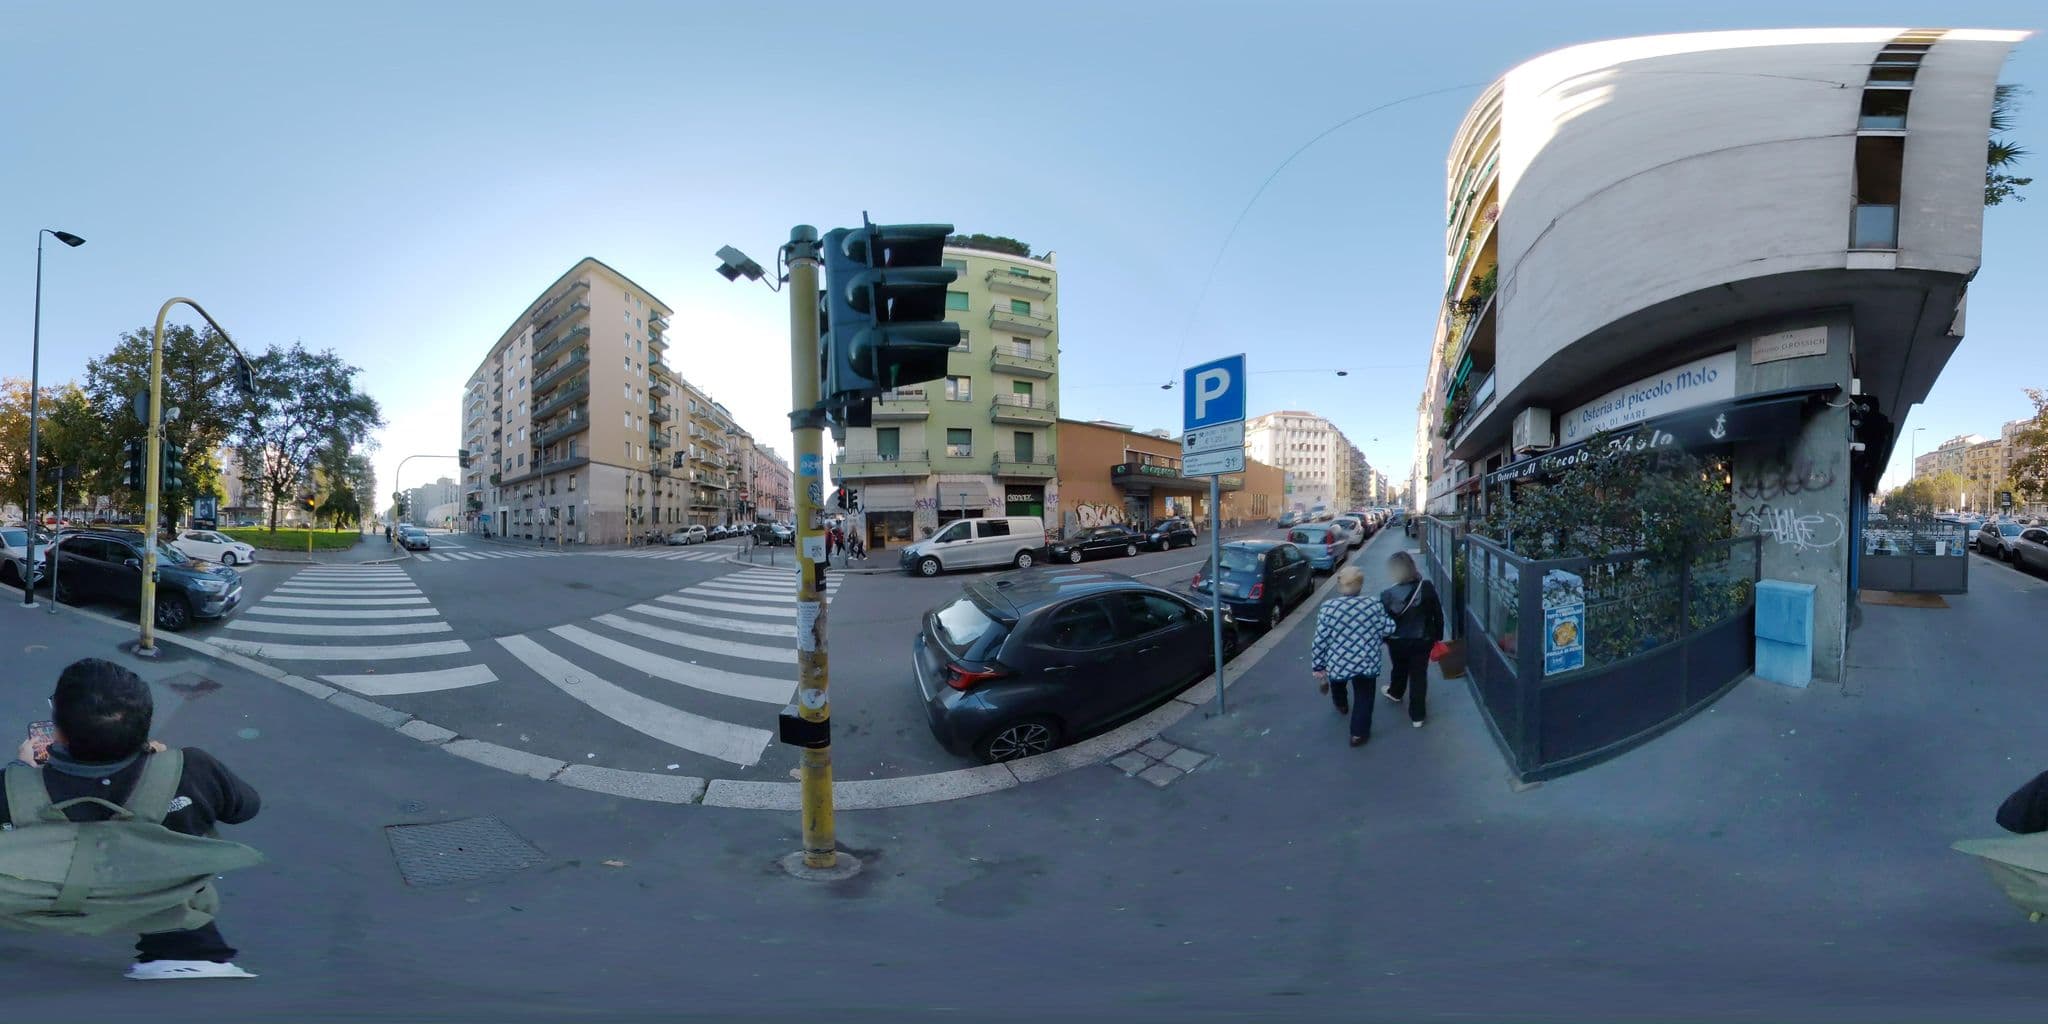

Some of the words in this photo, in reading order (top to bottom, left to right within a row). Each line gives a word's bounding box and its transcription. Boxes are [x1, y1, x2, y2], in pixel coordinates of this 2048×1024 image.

[1195, 367, 1231, 420] P
[1583, 402, 1612, 423] Osteria
[1615, 395, 1626, 410] al
[1628, 380, 1673, 410] piccolo
[1676, 366, 1717, 391] Molo
[1624, 408, 1646, 421] MARE
[1497, 469, 1519, 482] Osteria
[1522, 461, 1536, 476] Al
